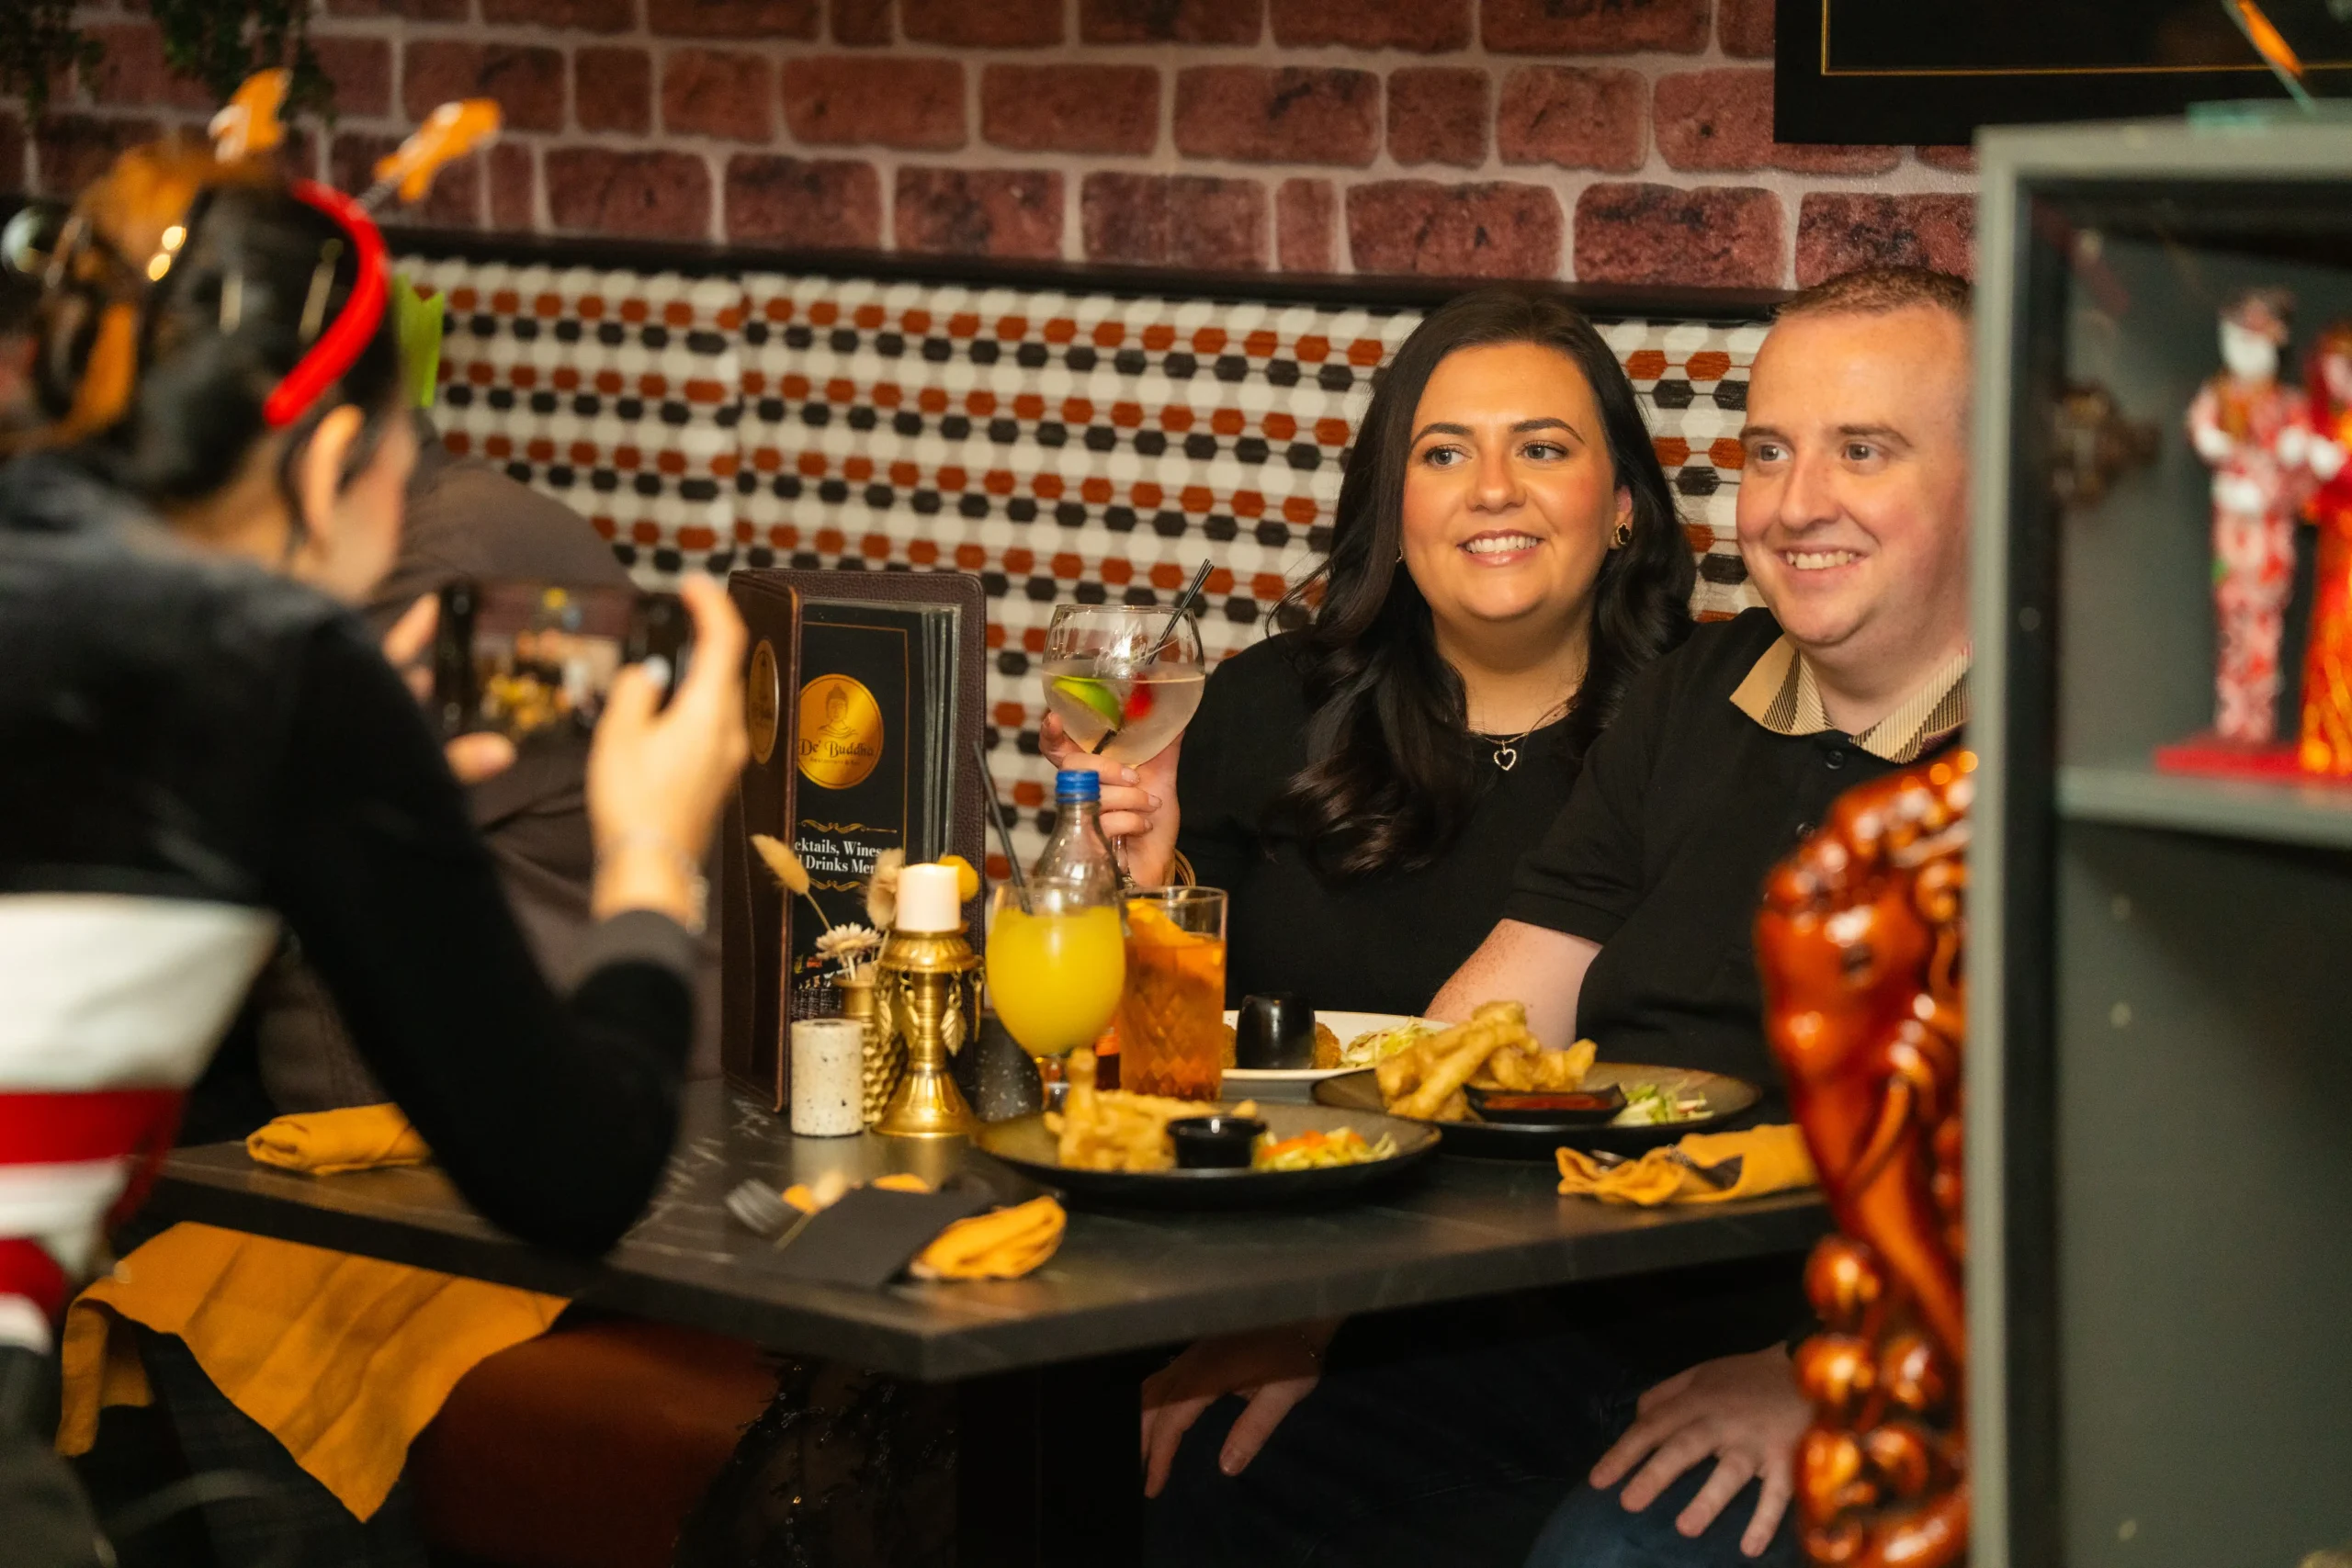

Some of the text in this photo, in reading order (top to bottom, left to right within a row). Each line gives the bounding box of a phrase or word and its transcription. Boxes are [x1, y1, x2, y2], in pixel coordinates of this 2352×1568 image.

[825, 741, 874, 758] Buddha
[795, 837, 840, 856] cktails,
[806, 855, 849, 873] Drinks
